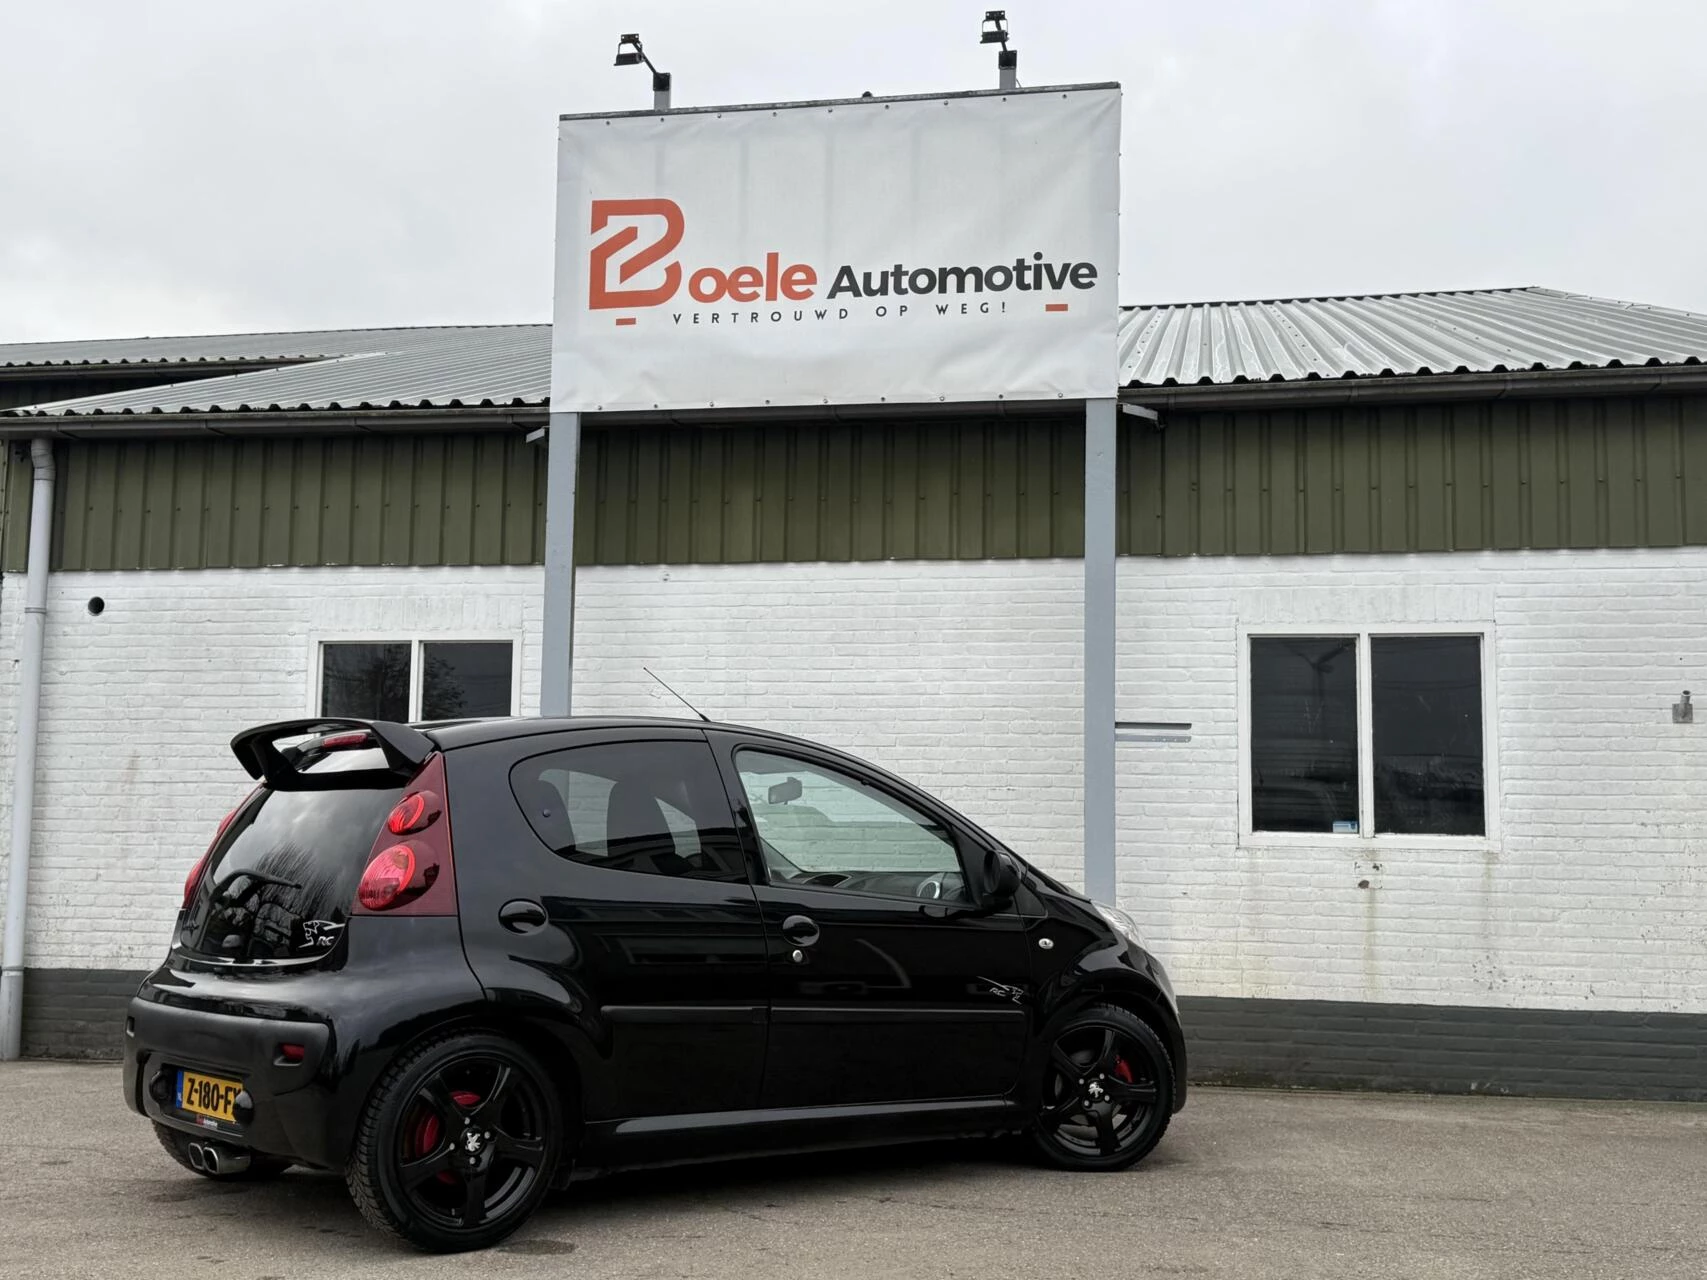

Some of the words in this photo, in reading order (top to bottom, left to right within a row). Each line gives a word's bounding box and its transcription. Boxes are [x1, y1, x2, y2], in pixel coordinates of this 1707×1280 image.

[826, 251, 1098, 300] Automotive
[672, 308, 849, 325] VERTROUWD
[875, 304, 908, 318] OP
[935, 301, 1007, 316] WEG!
